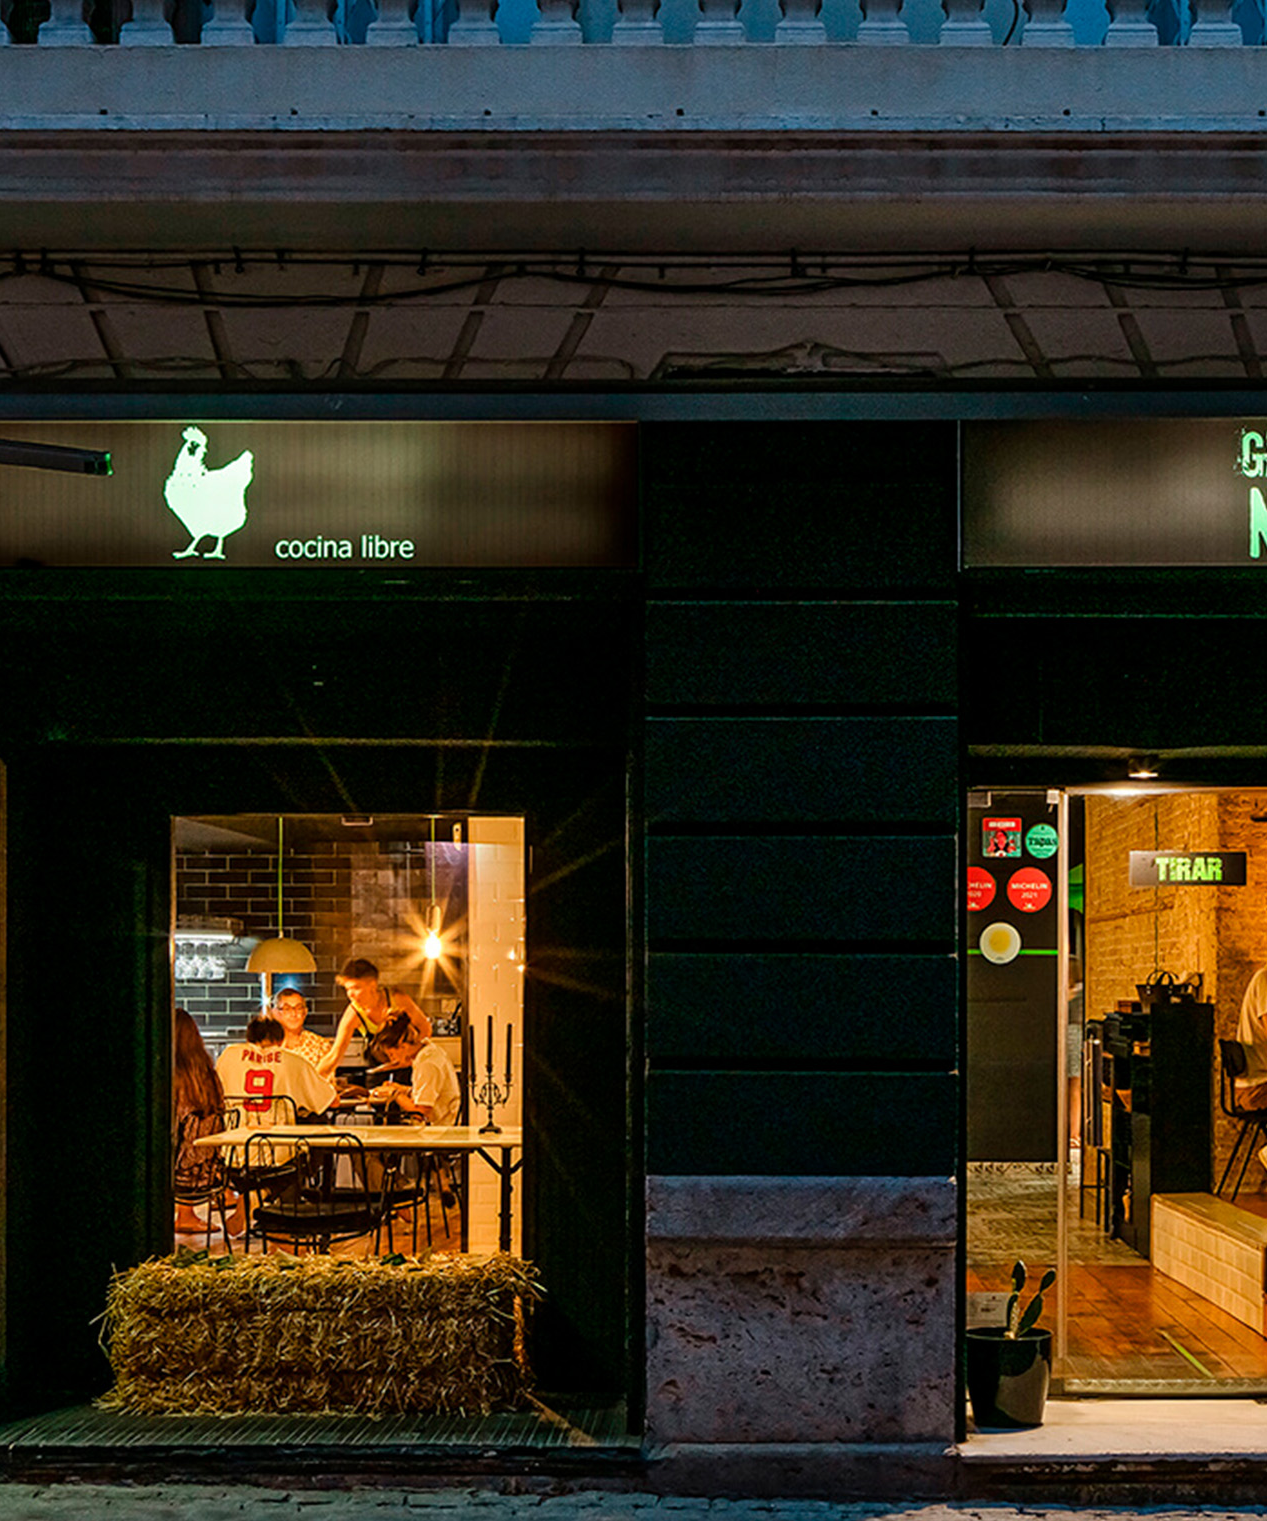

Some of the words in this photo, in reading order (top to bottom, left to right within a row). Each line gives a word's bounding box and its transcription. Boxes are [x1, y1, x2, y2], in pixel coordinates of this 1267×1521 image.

[275, 535, 352, 559] cocina
[361, 535, 415, 559] libre
[1155, 857, 1223, 881] TIRAR
[243, 1069, 274, 1112] 9
